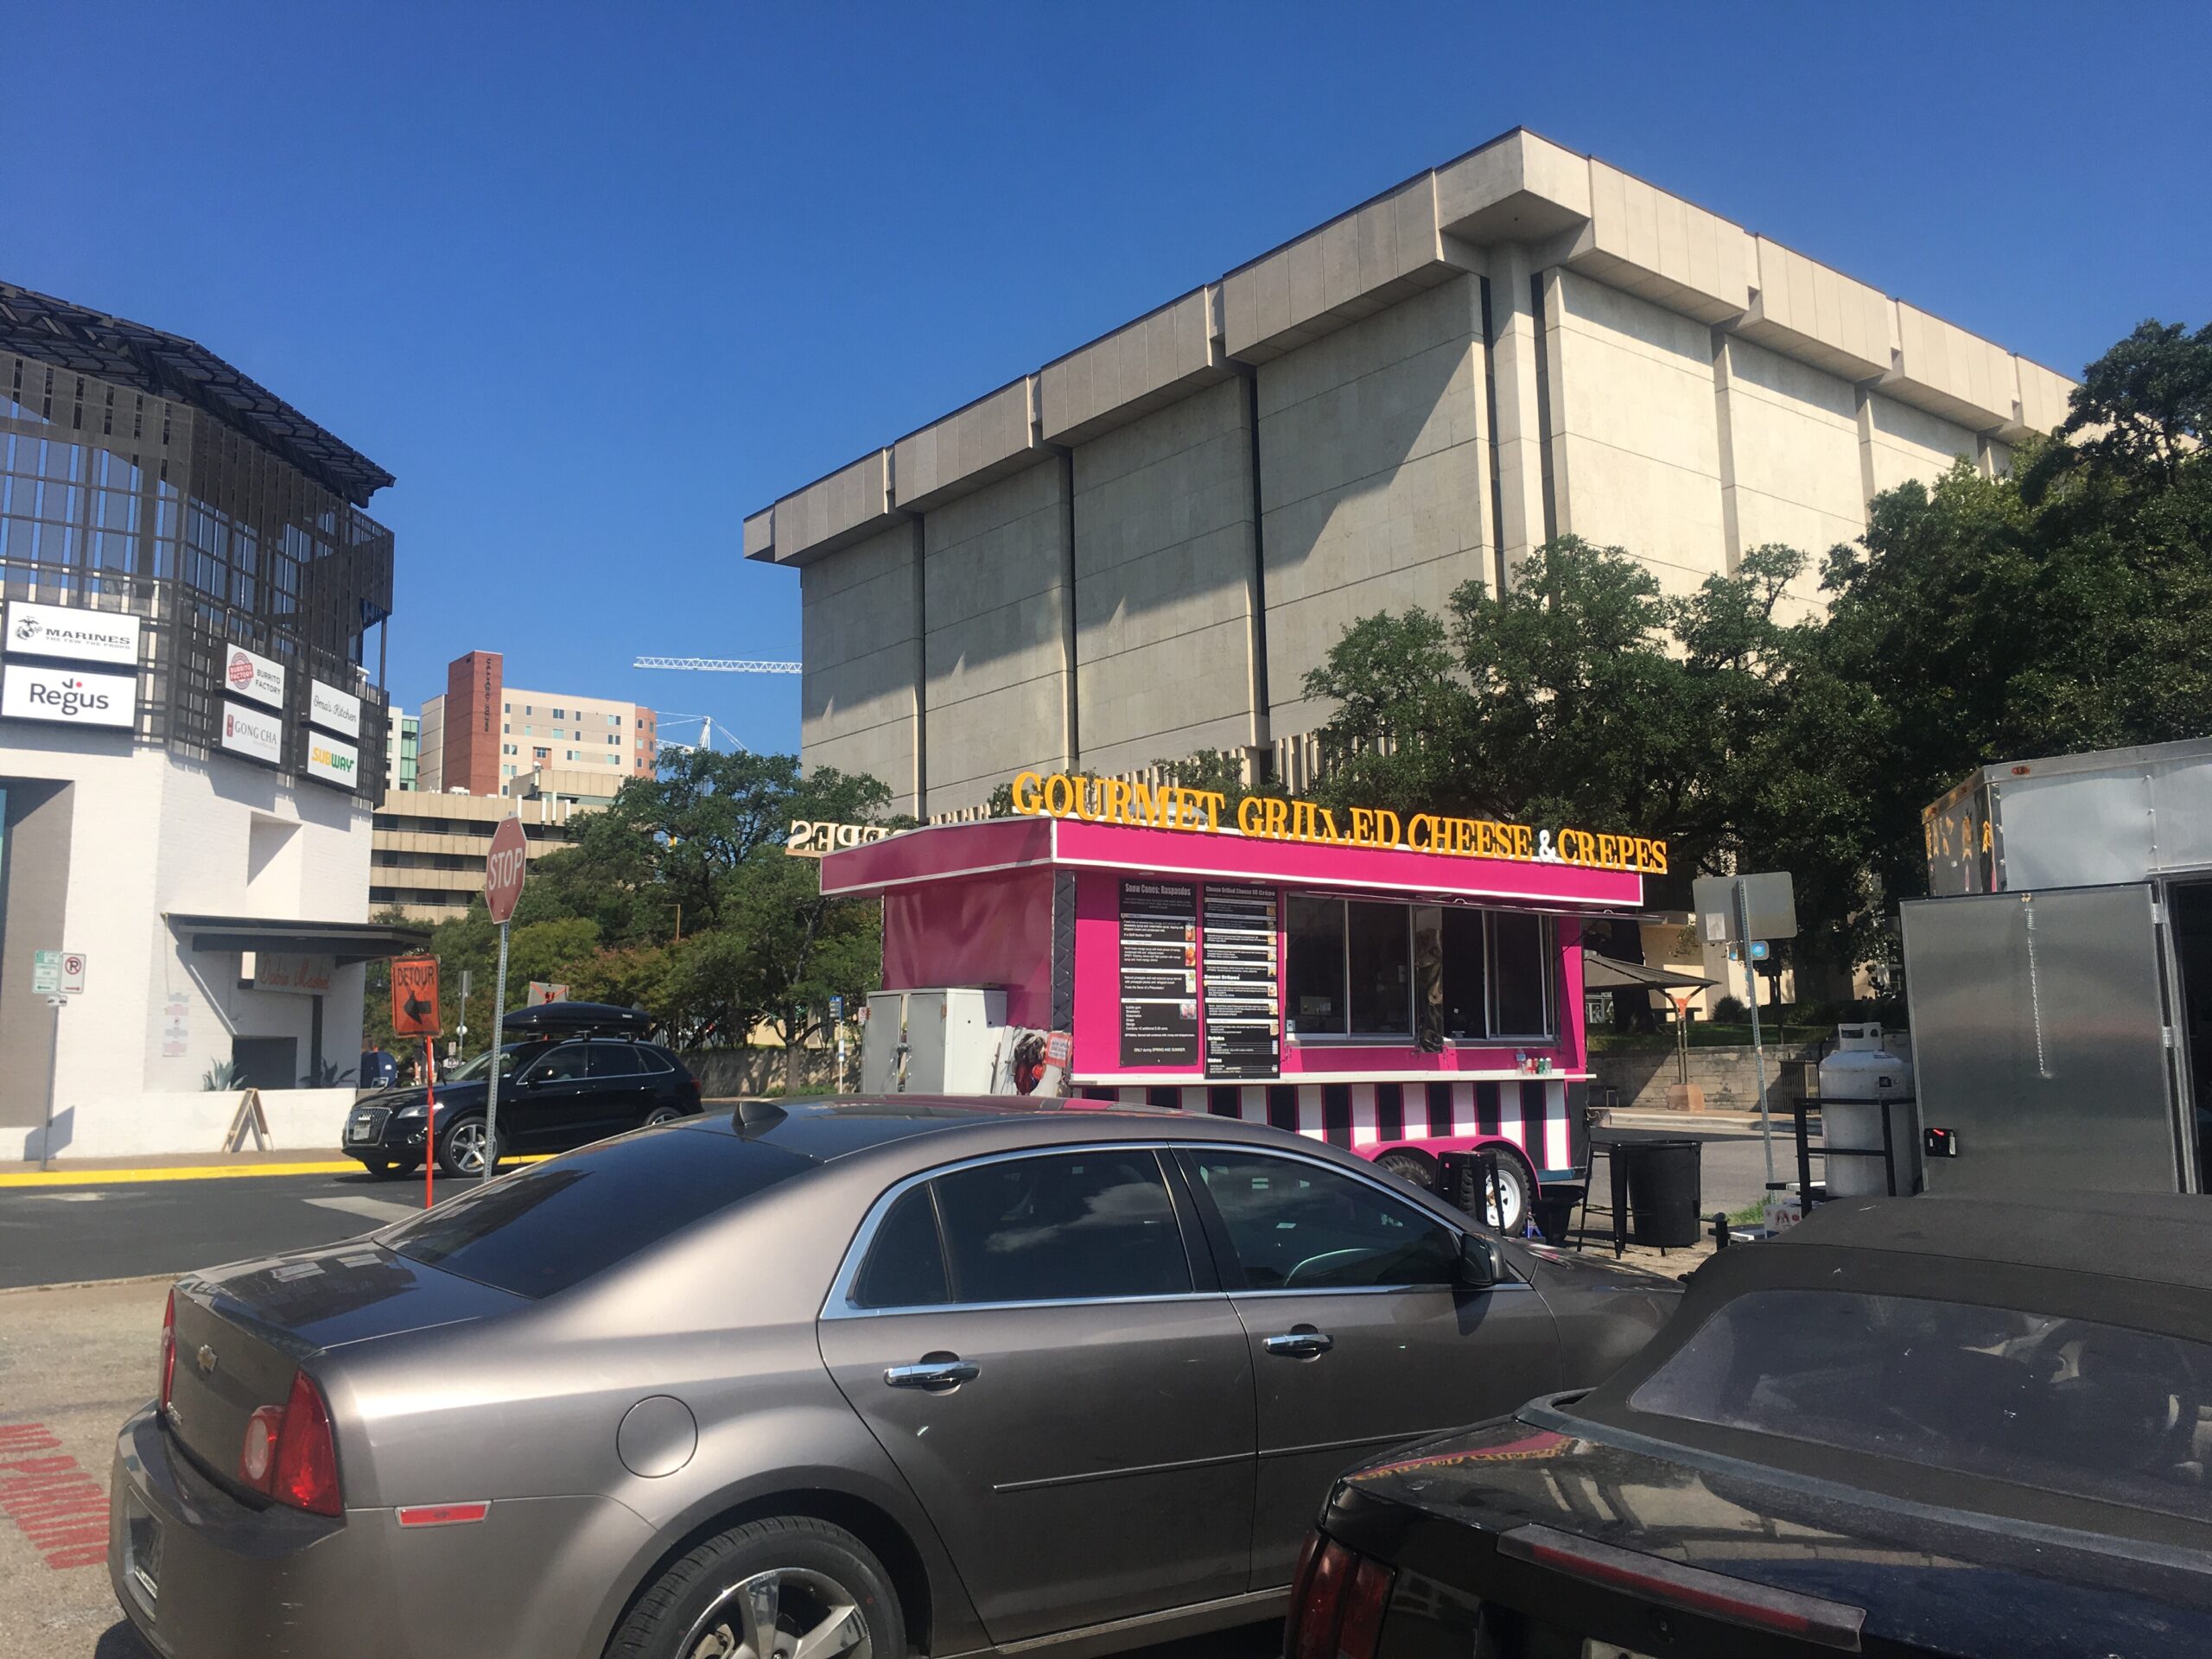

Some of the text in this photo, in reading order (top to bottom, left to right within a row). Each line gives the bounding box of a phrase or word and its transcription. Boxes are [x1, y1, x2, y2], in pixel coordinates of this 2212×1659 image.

[45, 628, 130, 645] MARINES
[257, 669, 281, 684] BURRITO
[255, 679, 281, 695] FACTORY
[29, 683, 109, 715] Regus
[334, 703, 357, 723] Kitchen
[234, 721, 258, 740] GONG
[260, 729, 277, 745] CHA
[311, 746, 355, 772] SUBWAY
[1012, 771, 1669, 874] GOURMET GRILLED CHEESE & CREPES
[488, 847, 524, 891] STOP
[1125, 883, 1141, 893] Snow
[397, 966, 435, 986] DETOUR
